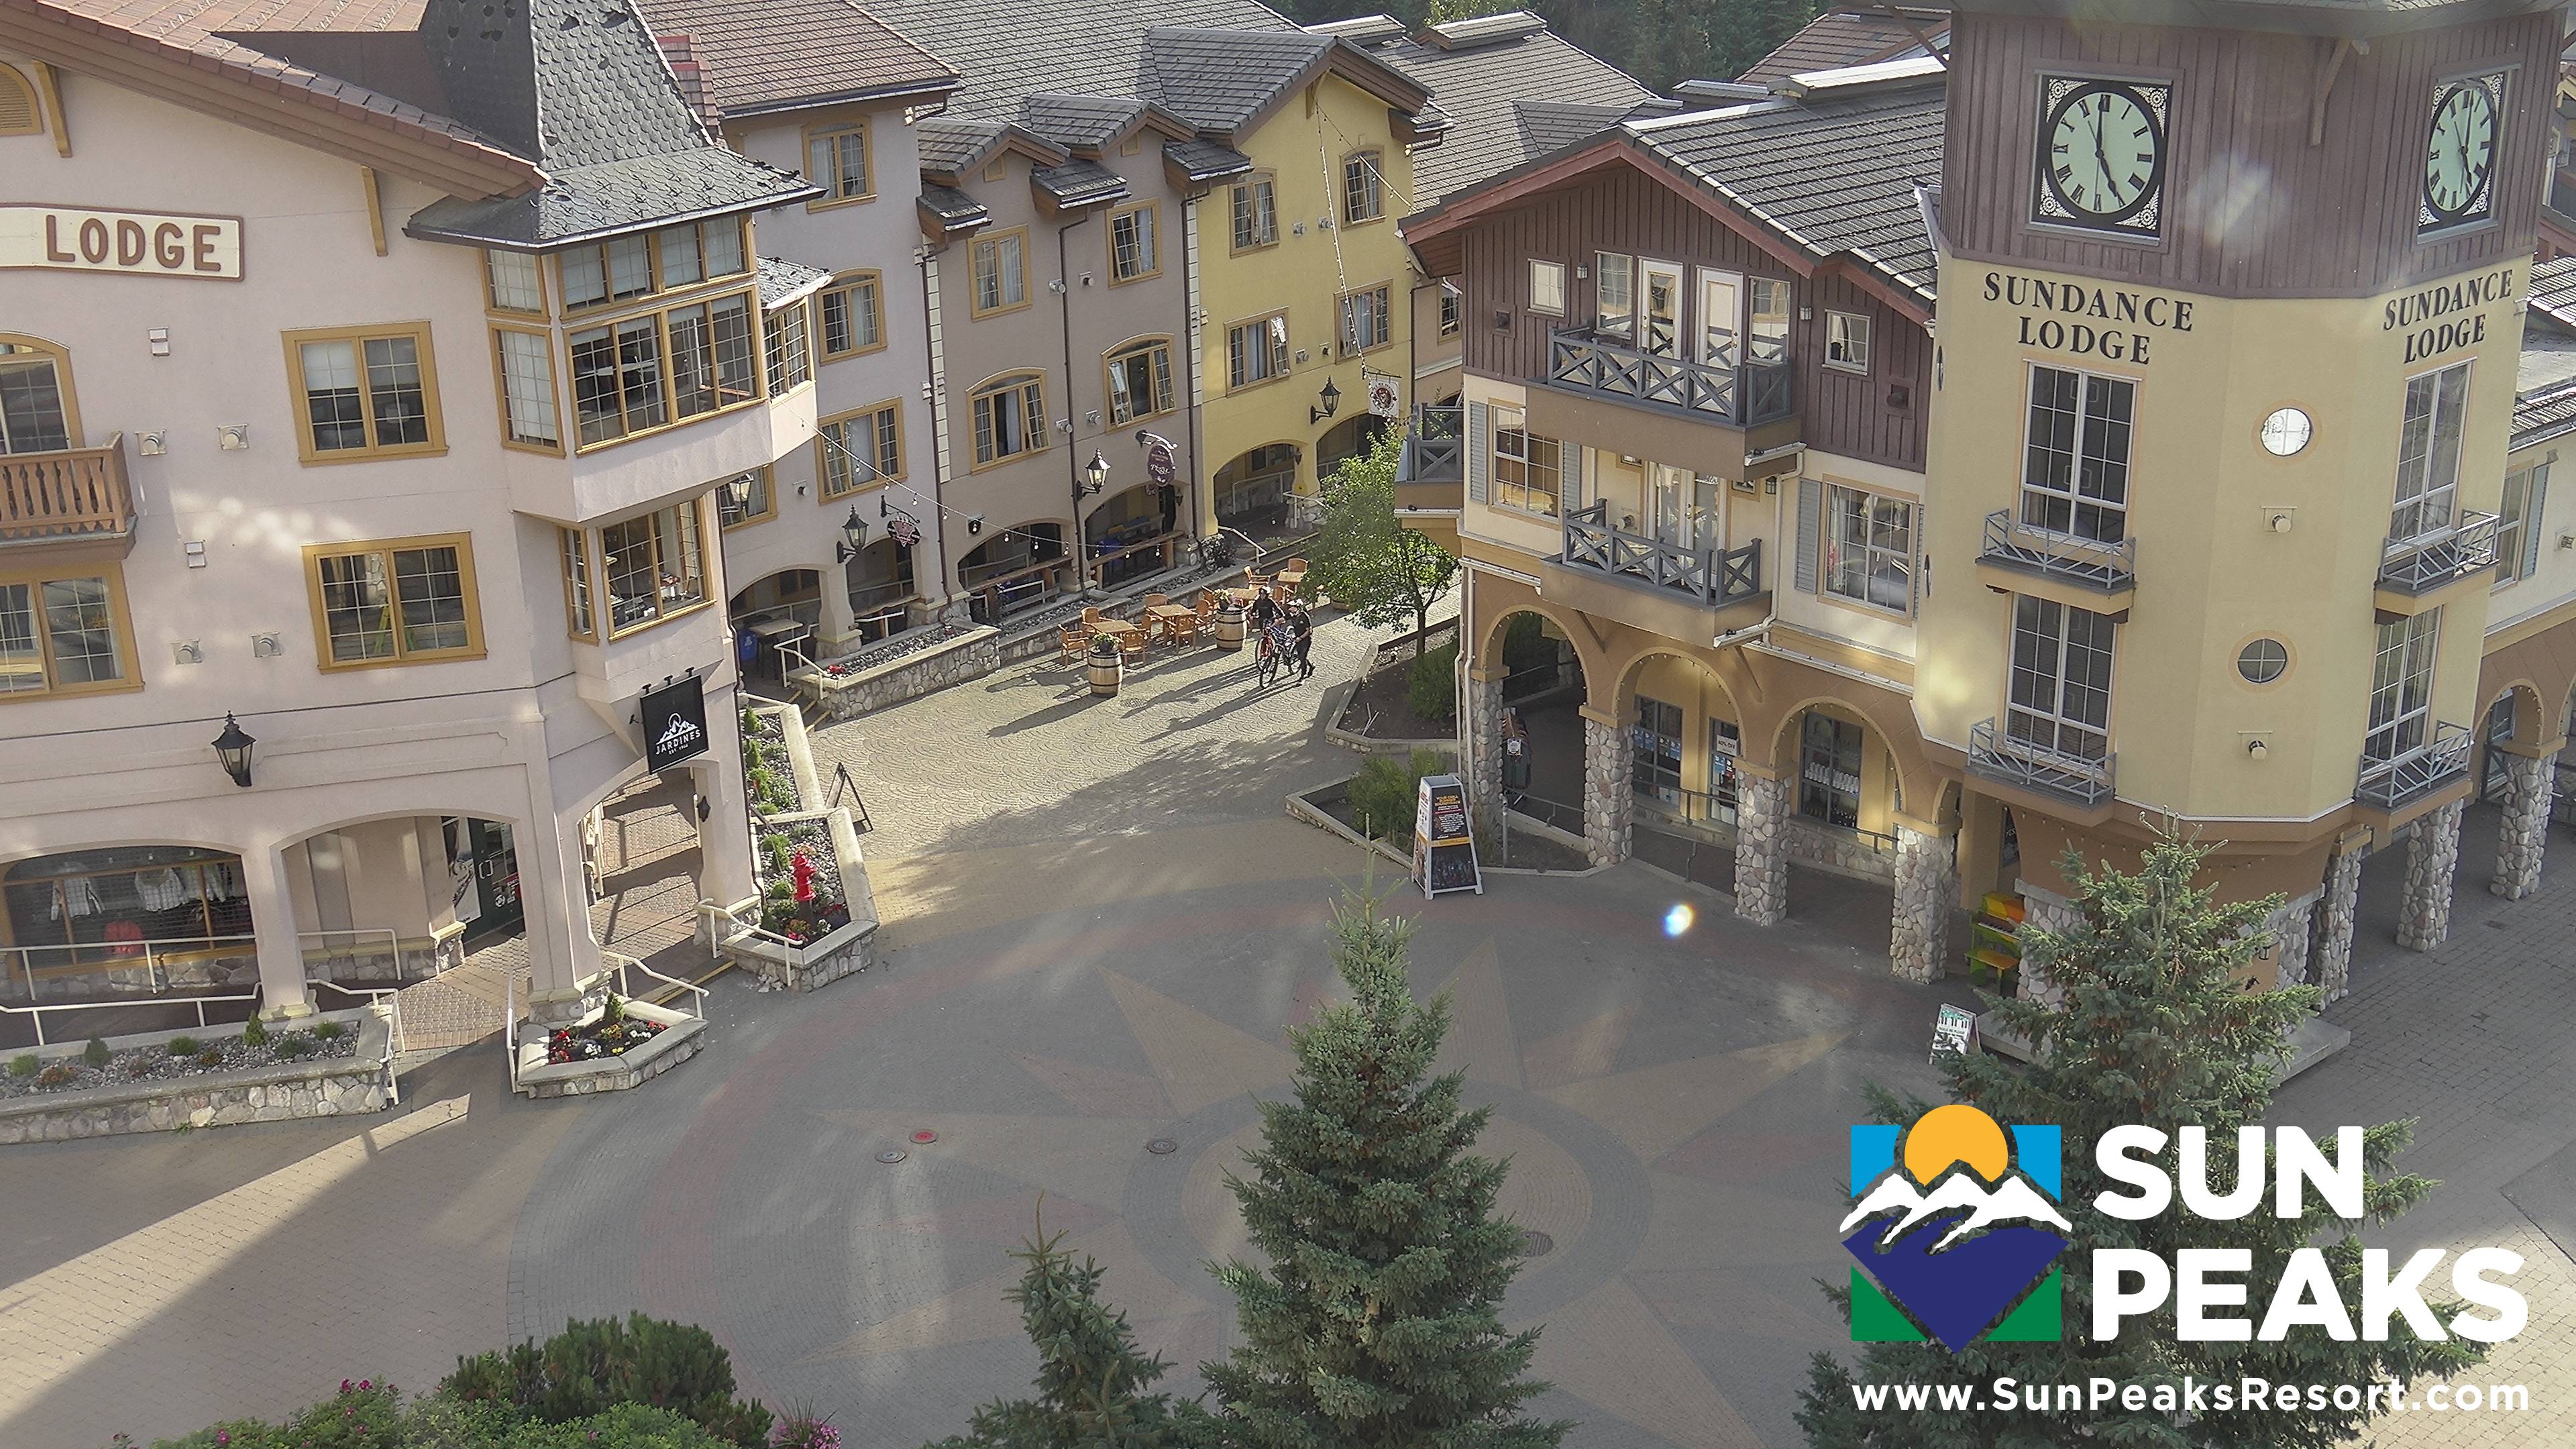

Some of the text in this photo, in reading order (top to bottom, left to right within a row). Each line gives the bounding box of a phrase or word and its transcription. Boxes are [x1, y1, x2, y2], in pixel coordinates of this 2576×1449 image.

[46, 215, 221, 272] LODGE
[1984, 272, 2193, 332] SUNDANCE
[2383, 269, 2513, 331] SUNDANCE
[2018, 316, 2151, 365] LODGE
[2404, 313, 2487, 364] LODGE
[655, 729, 701, 755] JARDINES
